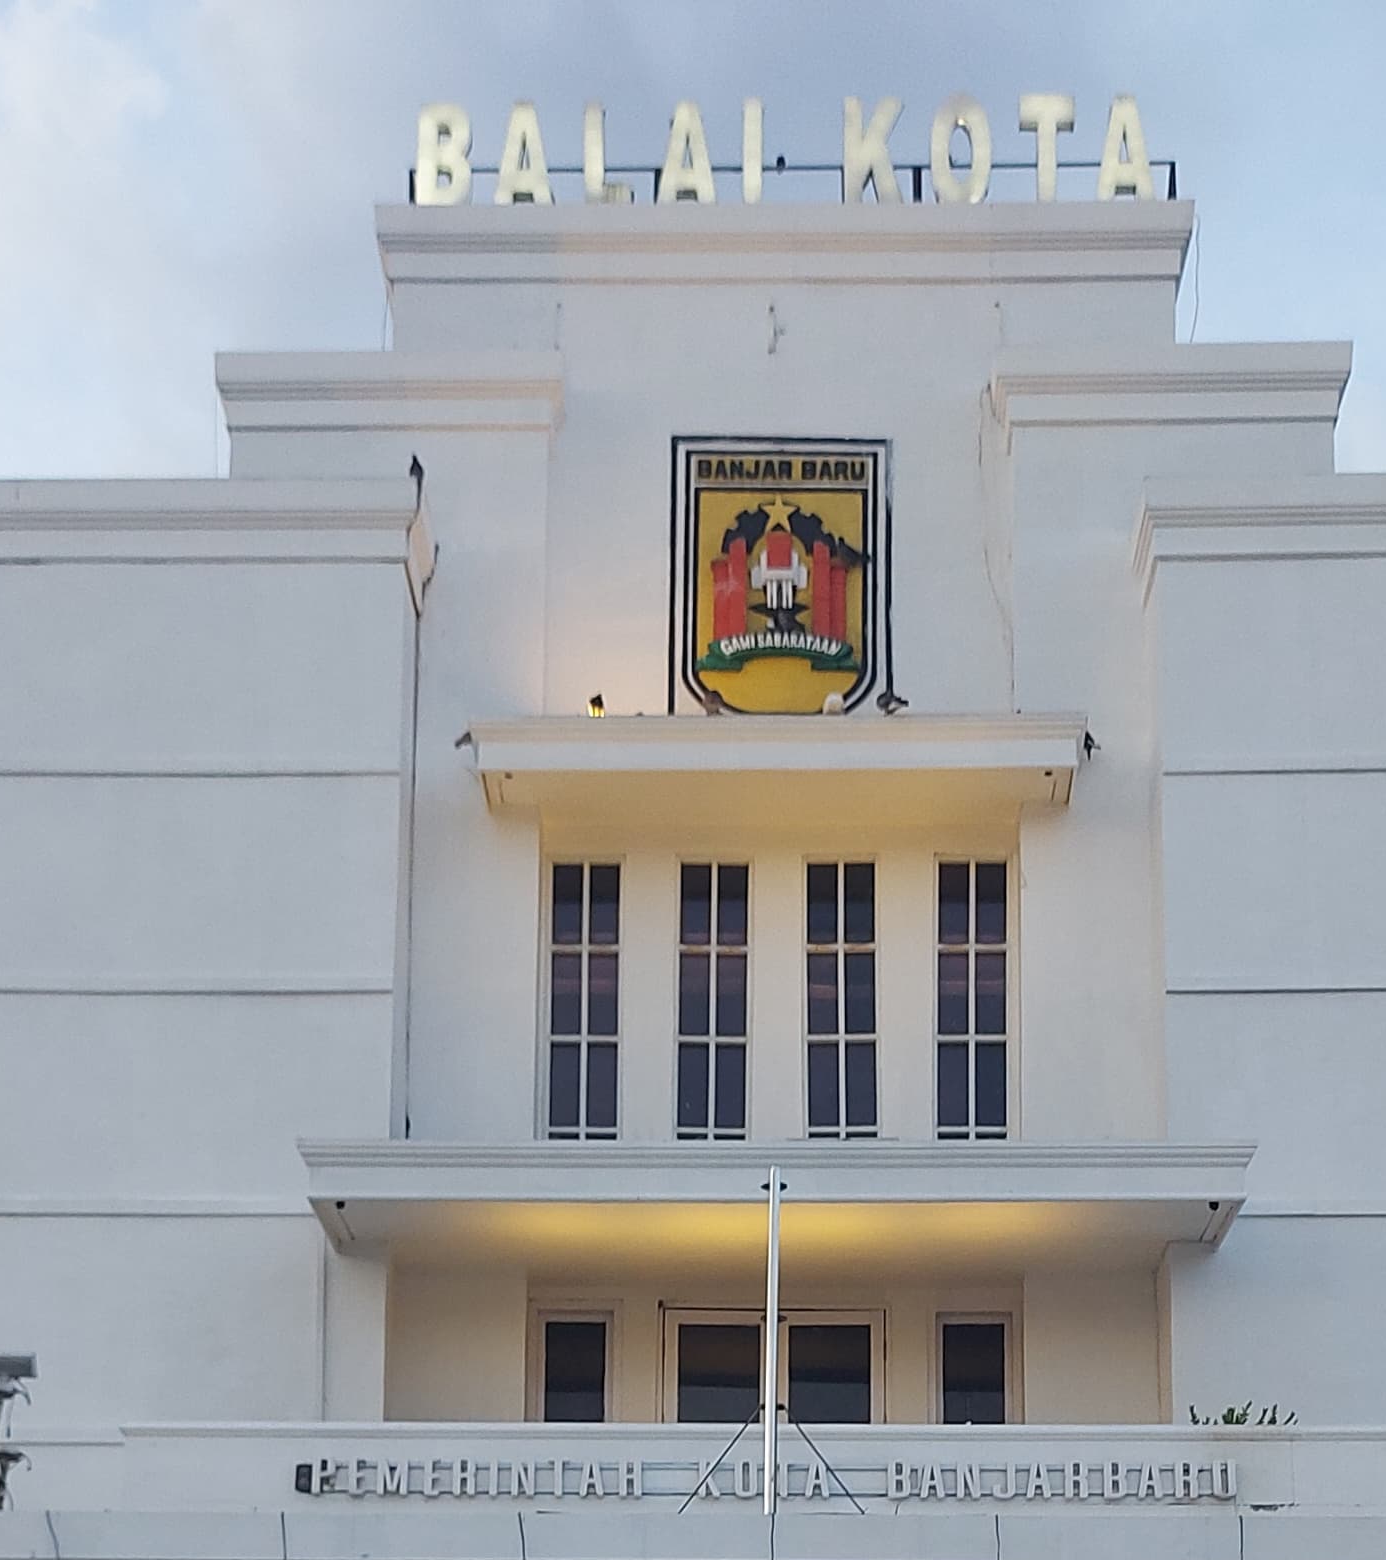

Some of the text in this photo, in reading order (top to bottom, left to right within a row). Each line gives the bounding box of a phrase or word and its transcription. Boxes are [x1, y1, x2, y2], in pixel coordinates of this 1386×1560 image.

[415, 94, 1156, 205] BALAI KOTA
[697, 459, 865, 481] BANJAR BARU
[311, 1458, 1237, 1500] PEMERINTAH KOTA BANJARBARU
